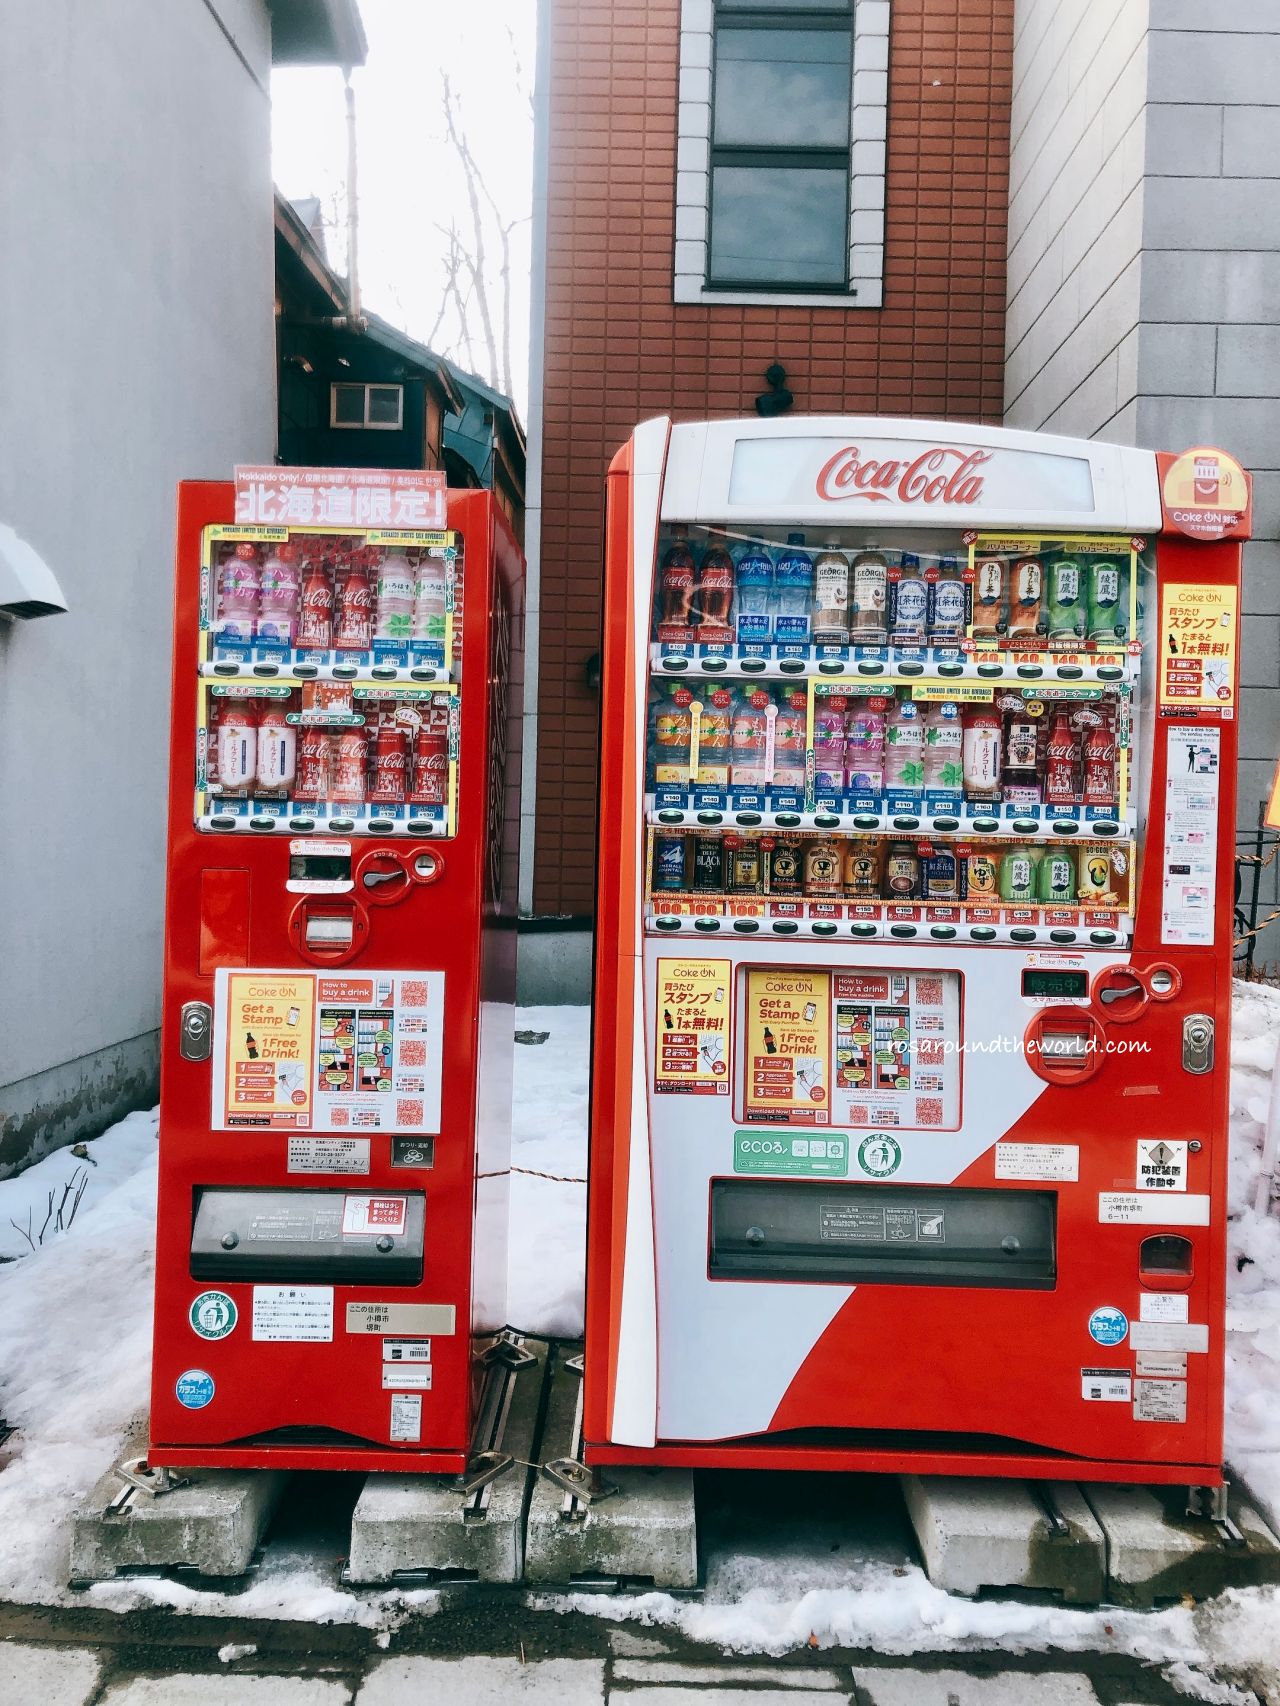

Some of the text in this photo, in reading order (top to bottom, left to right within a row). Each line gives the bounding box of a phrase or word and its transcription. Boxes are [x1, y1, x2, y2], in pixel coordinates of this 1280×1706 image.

[239, 472, 278, 481] Hokkaido
[816, 446, 995, 505] Coca-Cola
[238, 484, 443, 526] 北海道限定!
[1173, 511, 1201, 522] Coke
[1204, 512, 1221, 523] ON
[819, 567, 847, 576] GEORGIA
[857, 568, 885, 577] GEORGIA
[664, 574, 694, 587] Coca-Cola
[703, 575, 732, 588] Coca-Cola
[1060, 572, 1071, 594] 綾鷹
[1100, 573, 1111, 596] 綾鷹
[1179, 593, 1222, 602] Coke ON
[1169, 607, 1200, 616] 買うたび
[1168, 617, 1218, 629] スタンプ
[1182, 633, 1212, 641] たまると
[1181, 642, 1229, 656] 1本無料!
[1036, 689, 1089, 697] 北海道コーナー
[1168, 687, 1176, 695] 3
[982, 742, 990, 781] ミルクコーヒー
[1014, 863, 1024, 881] 綾鷹
[1053, 863, 1063, 881] 綾鷹
[673, 968, 716, 977] Coke ON
[664, 982, 695, 991] 買うたび
[765, 982, 813, 993] Coke ON
[838, 985, 853, 993] buy
[249, 986, 297, 998] Coke ON
[323, 989, 339, 997] buy
[664, 992, 713, 1004] スタンプ
[759, 998, 791, 1008] Get a
[242, 1004, 274, 1014] Get a
[677, 1008, 707, 1016] たまると
[242, 1014, 283, 1025] Stamp
[759, 1009, 800, 1021] Stamp
[676, 1017, 724, 1030] 1本無料!
[262, 1038, 298, 1048] 1 Free
[780, 1033, 815, 1043] 1 Free
[261, 1048, 299, 1058] Drink!
[780, 1044, 817, 1054] Drink!
[240, 1064, 246, 1072] 1
[665, 1062, 672, 1070] 3
[758, 1059, 764, 1068] 1
[238, 1078, 246, 1087] 2
[756, 1073, 764, 1082] 2
[238, 1092, 246, 1101] 3
[757, 1087, 764, 1096] 3
[1141, 1165, 1181, 1176] 防犯装置
[1145, 1178, 1176, 1188] 作動中
[366, 1323, 381, 1332] 堺町
